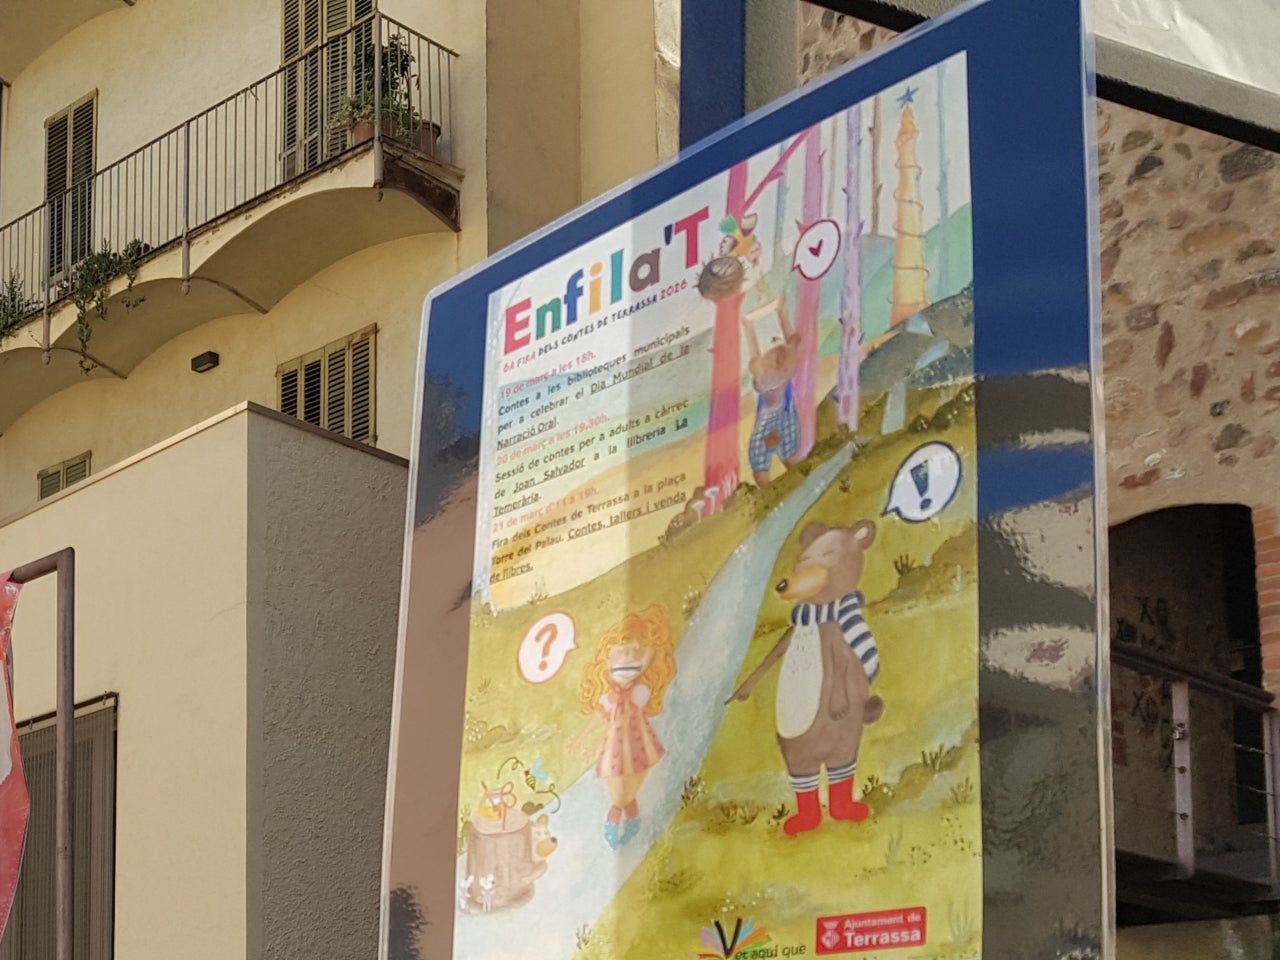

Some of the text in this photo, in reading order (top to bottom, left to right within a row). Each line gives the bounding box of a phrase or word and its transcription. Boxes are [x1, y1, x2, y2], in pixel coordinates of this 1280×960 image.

[503, 205, 710, 356] Enfila'T
[518, 353, 535, 367] FIRA
[538, 341, 558, 356] DELS
[561, 324, 595, 345] CONTES
[597, 317, 608, 329] DE
[611, 295, 658, 321] TERRASSA
[660, 280, 688, 300] 2026
[498, 420, 513, 435] per
[531, 396, 569, 418] celebrar
[575, 387, 584, 399] el
[591, 380, 606, 395] Dia
[613, 358, 653, 384] Mundial
[660, 352, 673, 364] de
[680, 345, 690, 356] la
[499, 326, 690, 416] Contes a les biblioteques municipals
[513, 383, 524, 394] de
[551, 368, 557, 377] a
[559, 362, 572, 373] les
[494, 418, 688, 499] de Joan Salvador a la llibreria La
[496, 400, 688, 482] Sessió de contes per a adults a càrrec
[496, 455, 508, 466] 20
[510, 449, 521, 459] de
[524, 440, 546, 457] març
[557, 429, 570, 441] les
[498, 417, 559, 449] Narració Oral.
[491, 550, 514, 566] Torre
[517, 544, 532, 556] del
[536, 535, 564, 550] Palau.
[609, 506, 642, 527] tallers
[654, 490, 686, 510] venda
[492, 473, 686, 550] Fira dels Contes de Terrassa a la plaça
[506, 516, 518, 527] de
[490, 572, 500, 583] de
[844, 912, 921, 930] Ajuntament de
[844, 928, 921, 948] Terrassa
[782, 945, 806, 958] que
